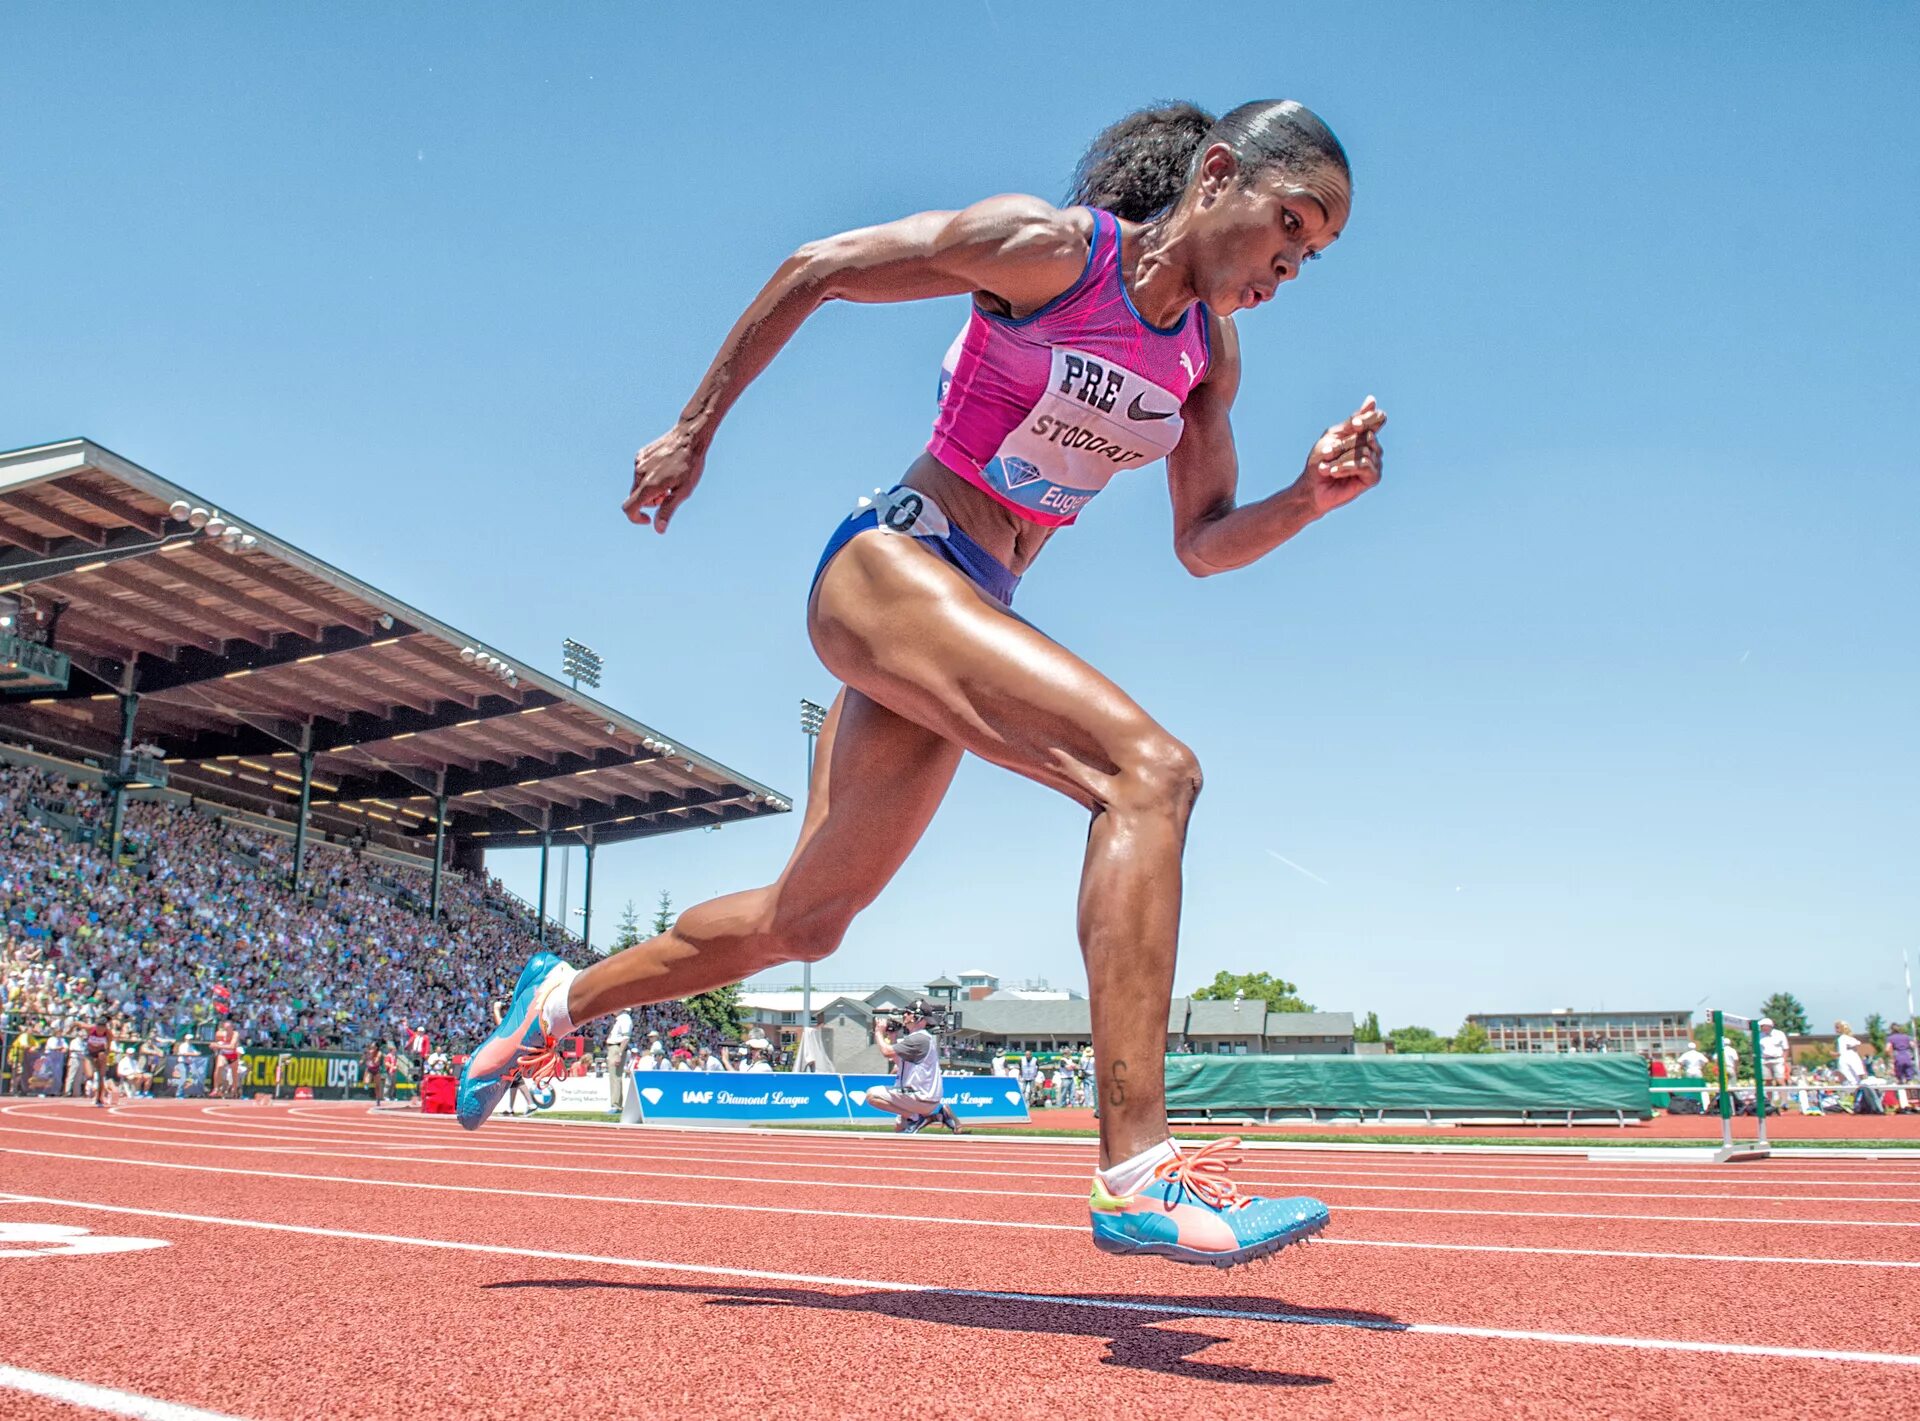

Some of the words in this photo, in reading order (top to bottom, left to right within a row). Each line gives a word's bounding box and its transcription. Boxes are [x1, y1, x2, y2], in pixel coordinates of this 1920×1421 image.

[1059, 354, 1125, 414] PRE
[327, 1058, 359, 1087] USA
[682, 1091, 714, 1104] IAAF
[716, 1090, 768, 1105] Diamond
[771, 1090, 810, 1108] League
[960, 1092, 993, 1108] League
